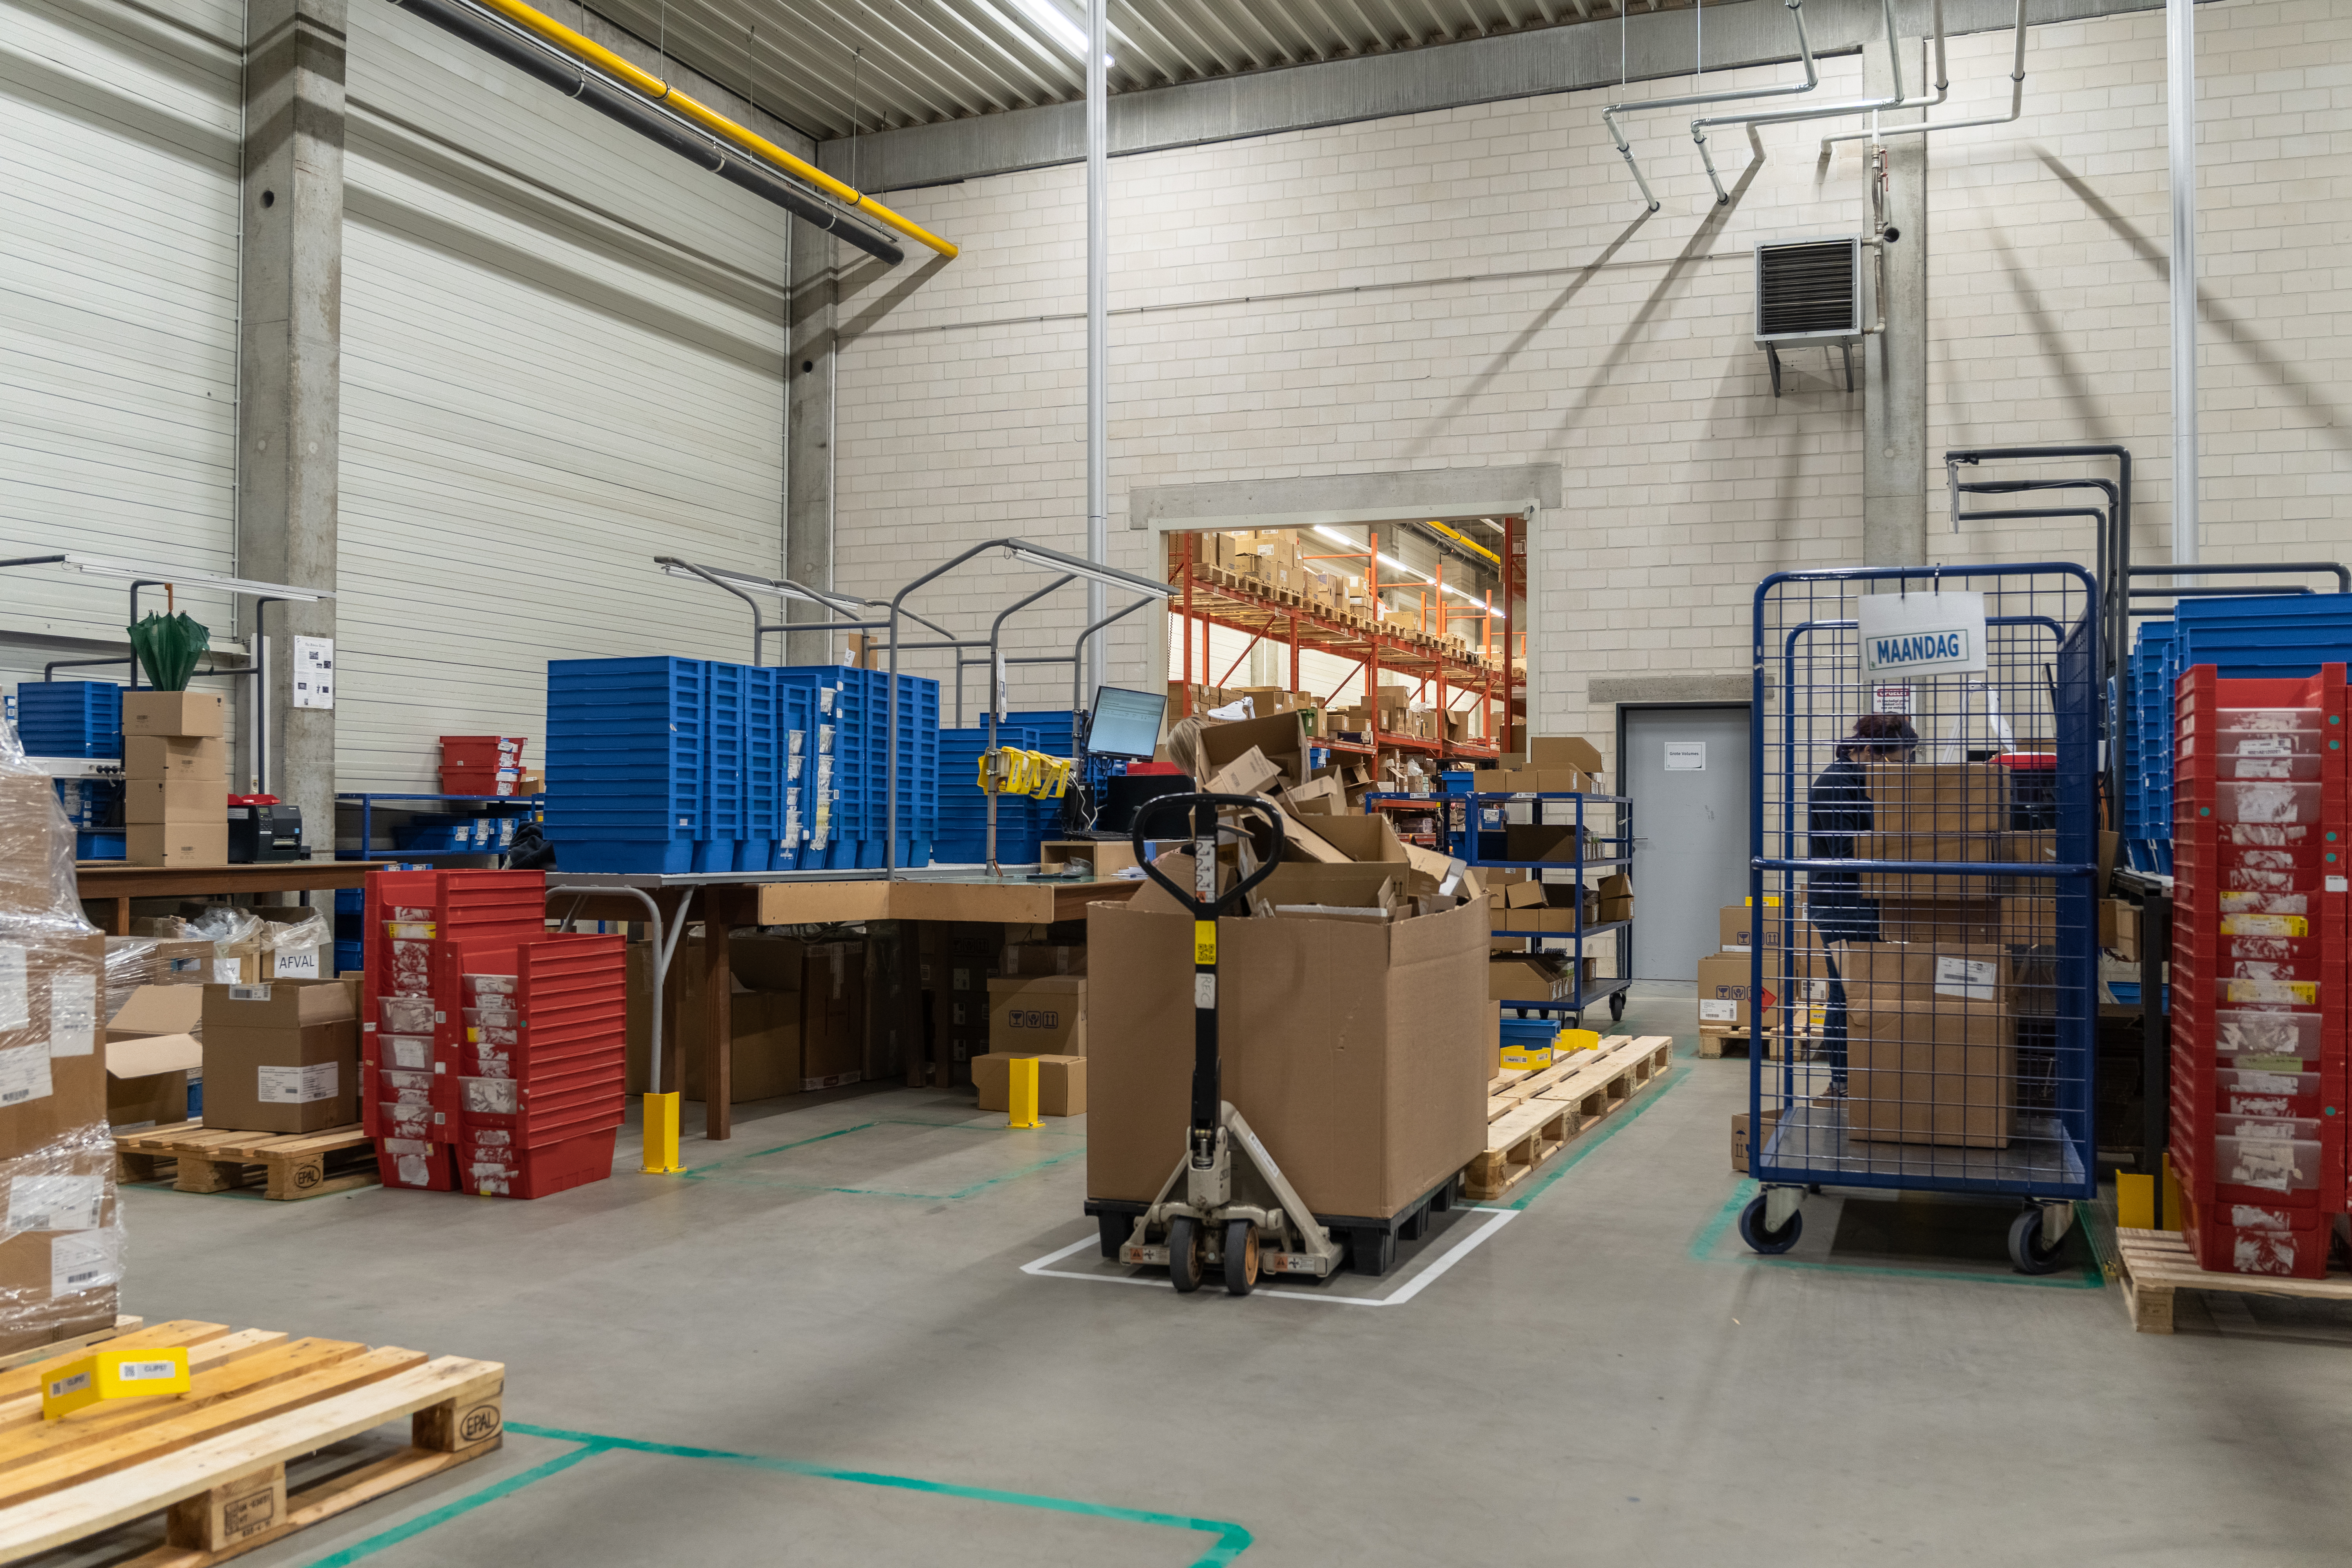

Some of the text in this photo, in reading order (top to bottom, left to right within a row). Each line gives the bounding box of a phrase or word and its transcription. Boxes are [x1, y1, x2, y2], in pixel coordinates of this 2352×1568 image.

[1877, 633, 1959, 664] MAANDAG
[279, 955, 314, 969] AFVAL
[1200, 976, 1213, 1002] REC
[298, 1170, 317, 1184] EPAL
[466, 1411, 495, 1436] EPAL
